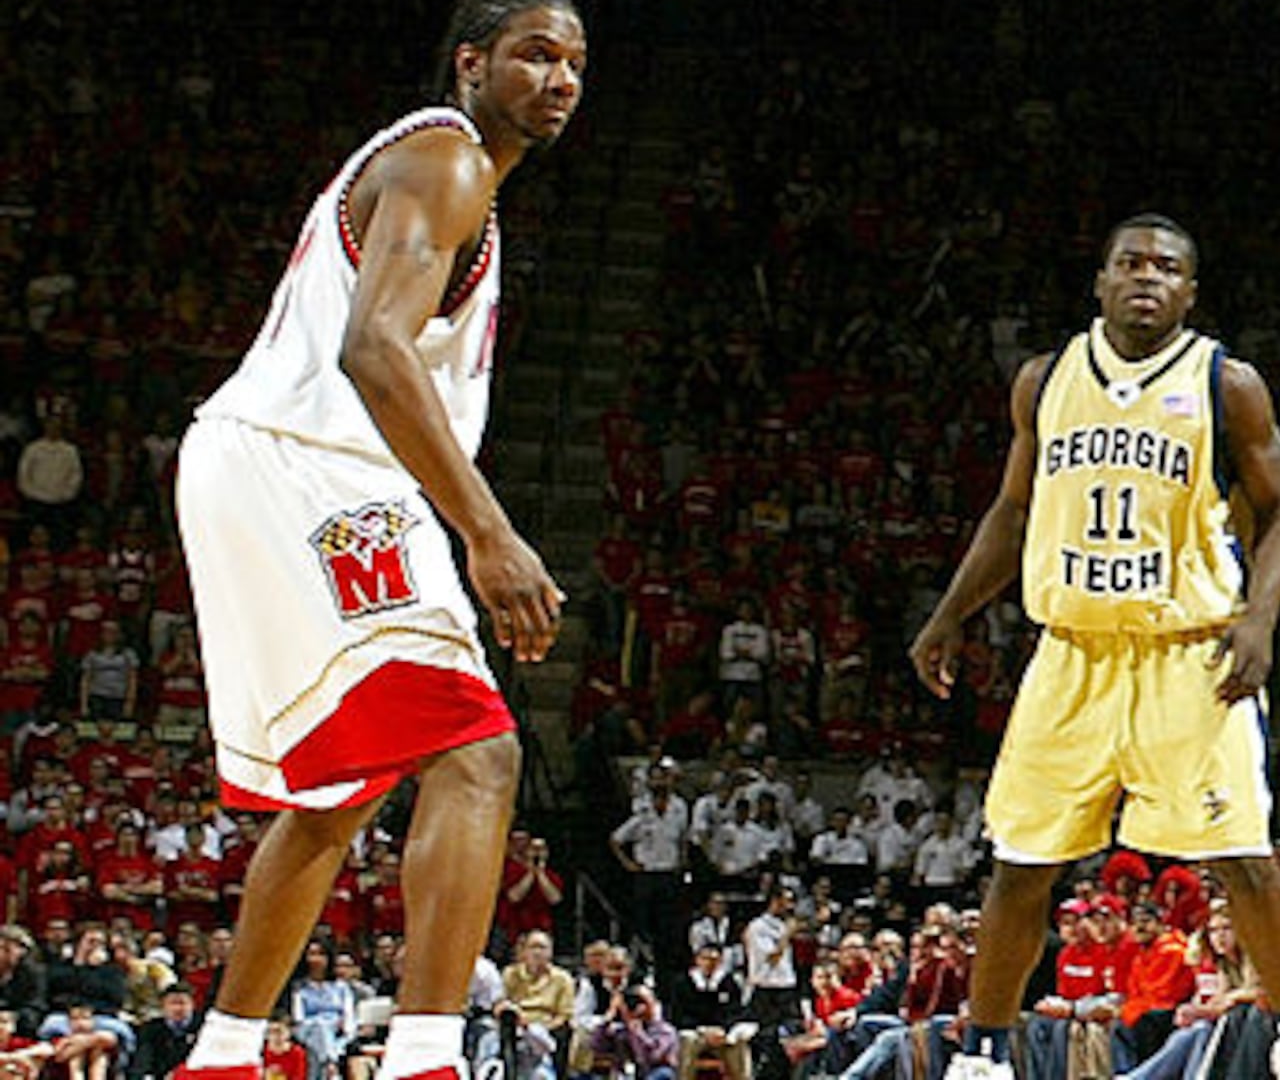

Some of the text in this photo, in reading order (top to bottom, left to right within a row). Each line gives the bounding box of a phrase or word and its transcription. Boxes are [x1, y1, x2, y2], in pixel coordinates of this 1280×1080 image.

[1046, 425, 1193, 488] GEORGIA
[1085, 483, 1139, 541] 11
[327, 542, 418, 618] M
[1059, 546, 1165, 594] TECH
